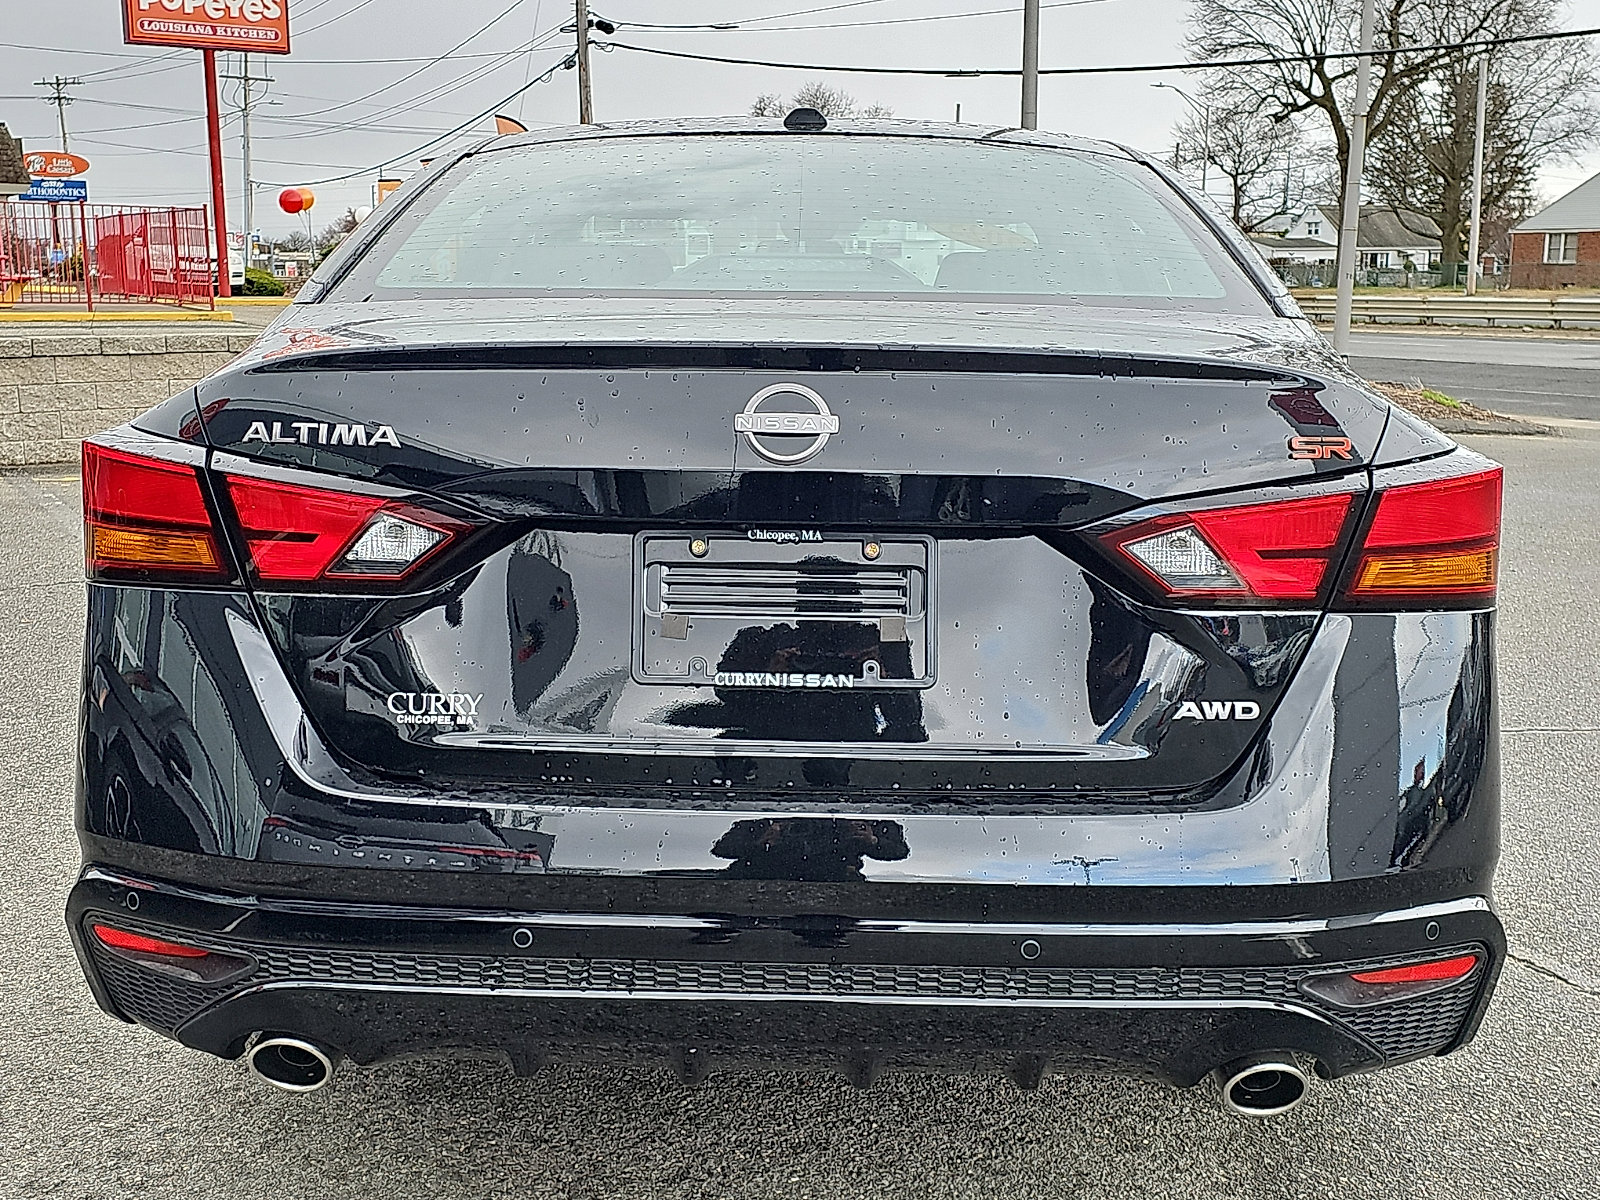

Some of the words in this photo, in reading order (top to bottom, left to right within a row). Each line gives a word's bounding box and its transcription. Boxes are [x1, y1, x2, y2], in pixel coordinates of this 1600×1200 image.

[142, 20, 214, 36] LOUISIANA
[216, 26, 276, 40] KITCHEN
[737, 415, 838, 432] NISSAN
[241, 421, 401, 448] ALTIMA
[1290, 435, 1354, 460] SR
[747, 529, 799, 543] Chicopee,
[801, 529, 823, 541] MA
[387, 691, 485, 716] CURRY
[1171, 700, 1261, 720] AWD
[396, 714, 455, 726] CHICOPEE,
[456, 715, 474, 725] MA
